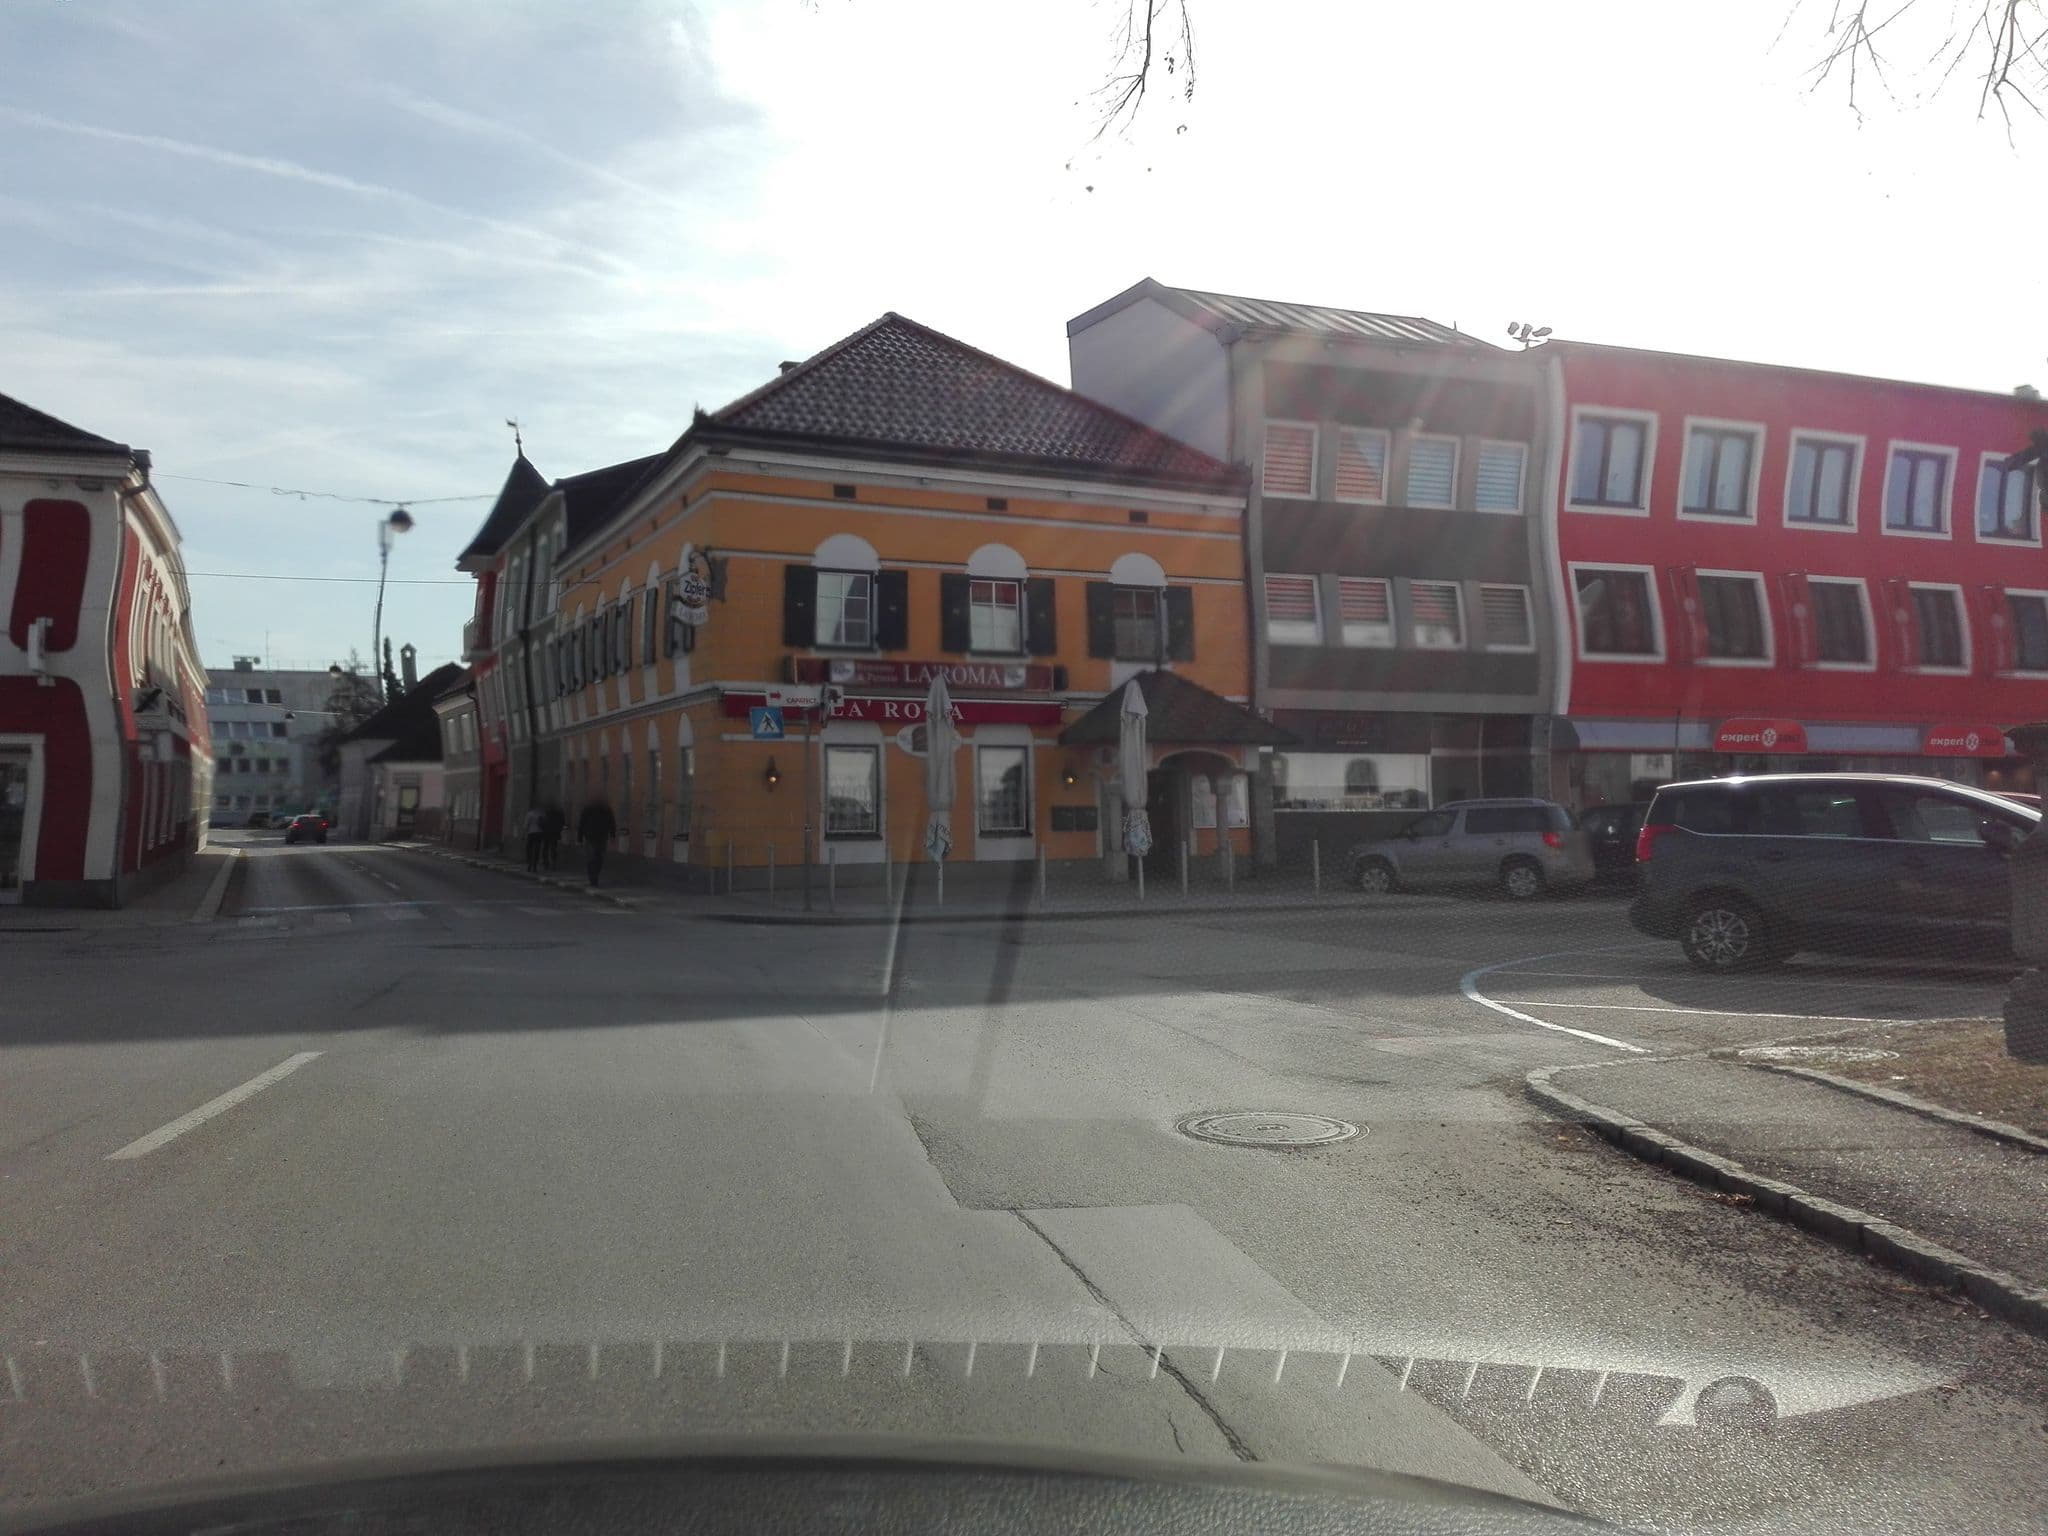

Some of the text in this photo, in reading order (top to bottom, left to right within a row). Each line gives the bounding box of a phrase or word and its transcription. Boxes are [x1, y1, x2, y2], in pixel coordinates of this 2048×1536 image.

[883, 702, 966, 721] ROA
[1721, 733, 1761, 744] expert
[1930, 737, 1964, 747] expert
